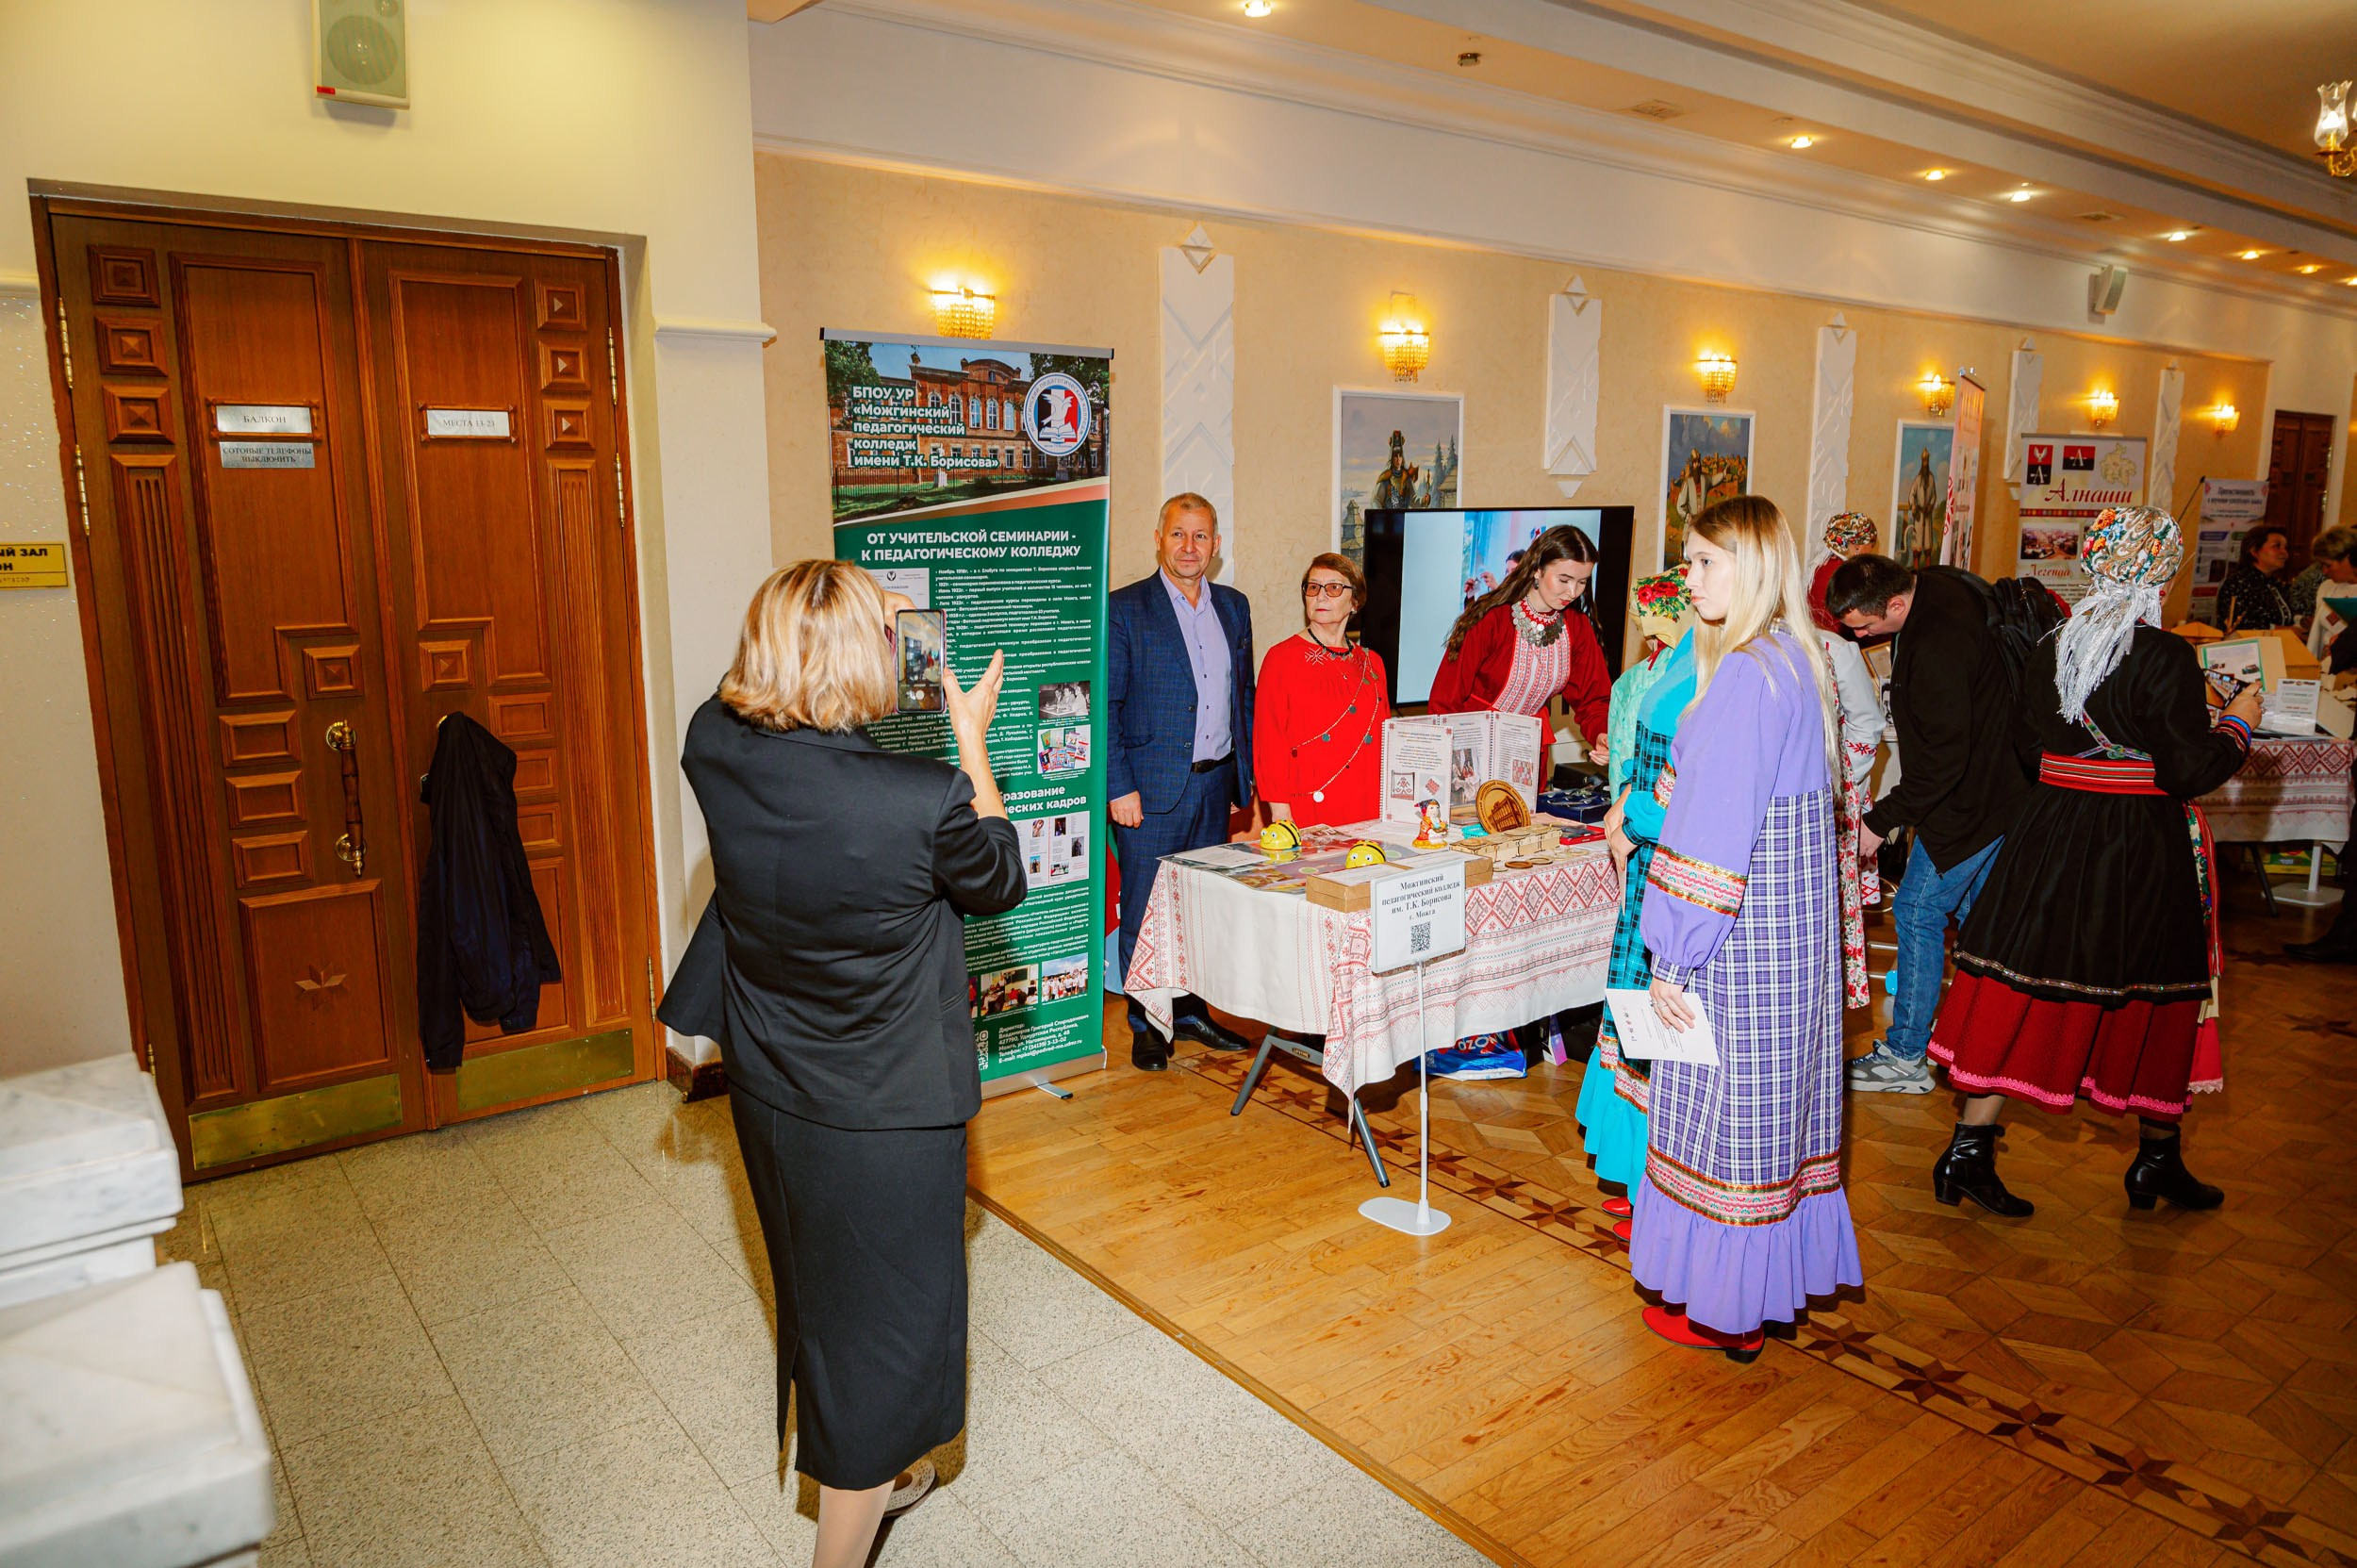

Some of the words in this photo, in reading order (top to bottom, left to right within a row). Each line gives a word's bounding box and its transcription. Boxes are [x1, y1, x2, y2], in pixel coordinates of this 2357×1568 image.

[852, 386, 894, 399] БПОУ
[895, 387, 915, 401] УР
[853, 404, 950, 420] «Можгинский
[853, 421, 965, 436] педагогический
[265, 447, 312, 455] ТЕЛЕФОНЫ
[853, 439, 916, 452] колледж
[854, 454, 900, 468] имени
[904, 456, 928, 468] Т.К.
[931, 456, 999, 470] Борисова»
[2044, 478, 2133, 503] Алнаши
[867, 532, 886, 545] ОТ
[889, 529, 988, 545] УЧИТЕЛЬСКОЙ
[989, 530, 1069, 543] СЕМИНАРИИ
[19, 548, 48, 557] ЗАЛ
[861, 550, 871, 561] К
[874, 546, 1008, 561] ПЕДАГОГИЧЕСКОМУ
[1011, 545, 1081, 559] КОЛЛЕДЖУ
[1046, 795, 1087, 810] кадров
[1400, 874, 1444, 891] Можгинский
[1381, 887, 1434, 906] педагогический
[1434, 881, 1461, 895] колледж
[1391, 906, 1403, 915] им.
[1405, 900, 1420, 911] Т.К.
[1421, 893, 1452, 908] Борисова
[1416, 909, 1436, 919] Можга
[999, 1023, 1025, 1034] Директор:
[1030, 1022, 1054, 1032] Григорий
